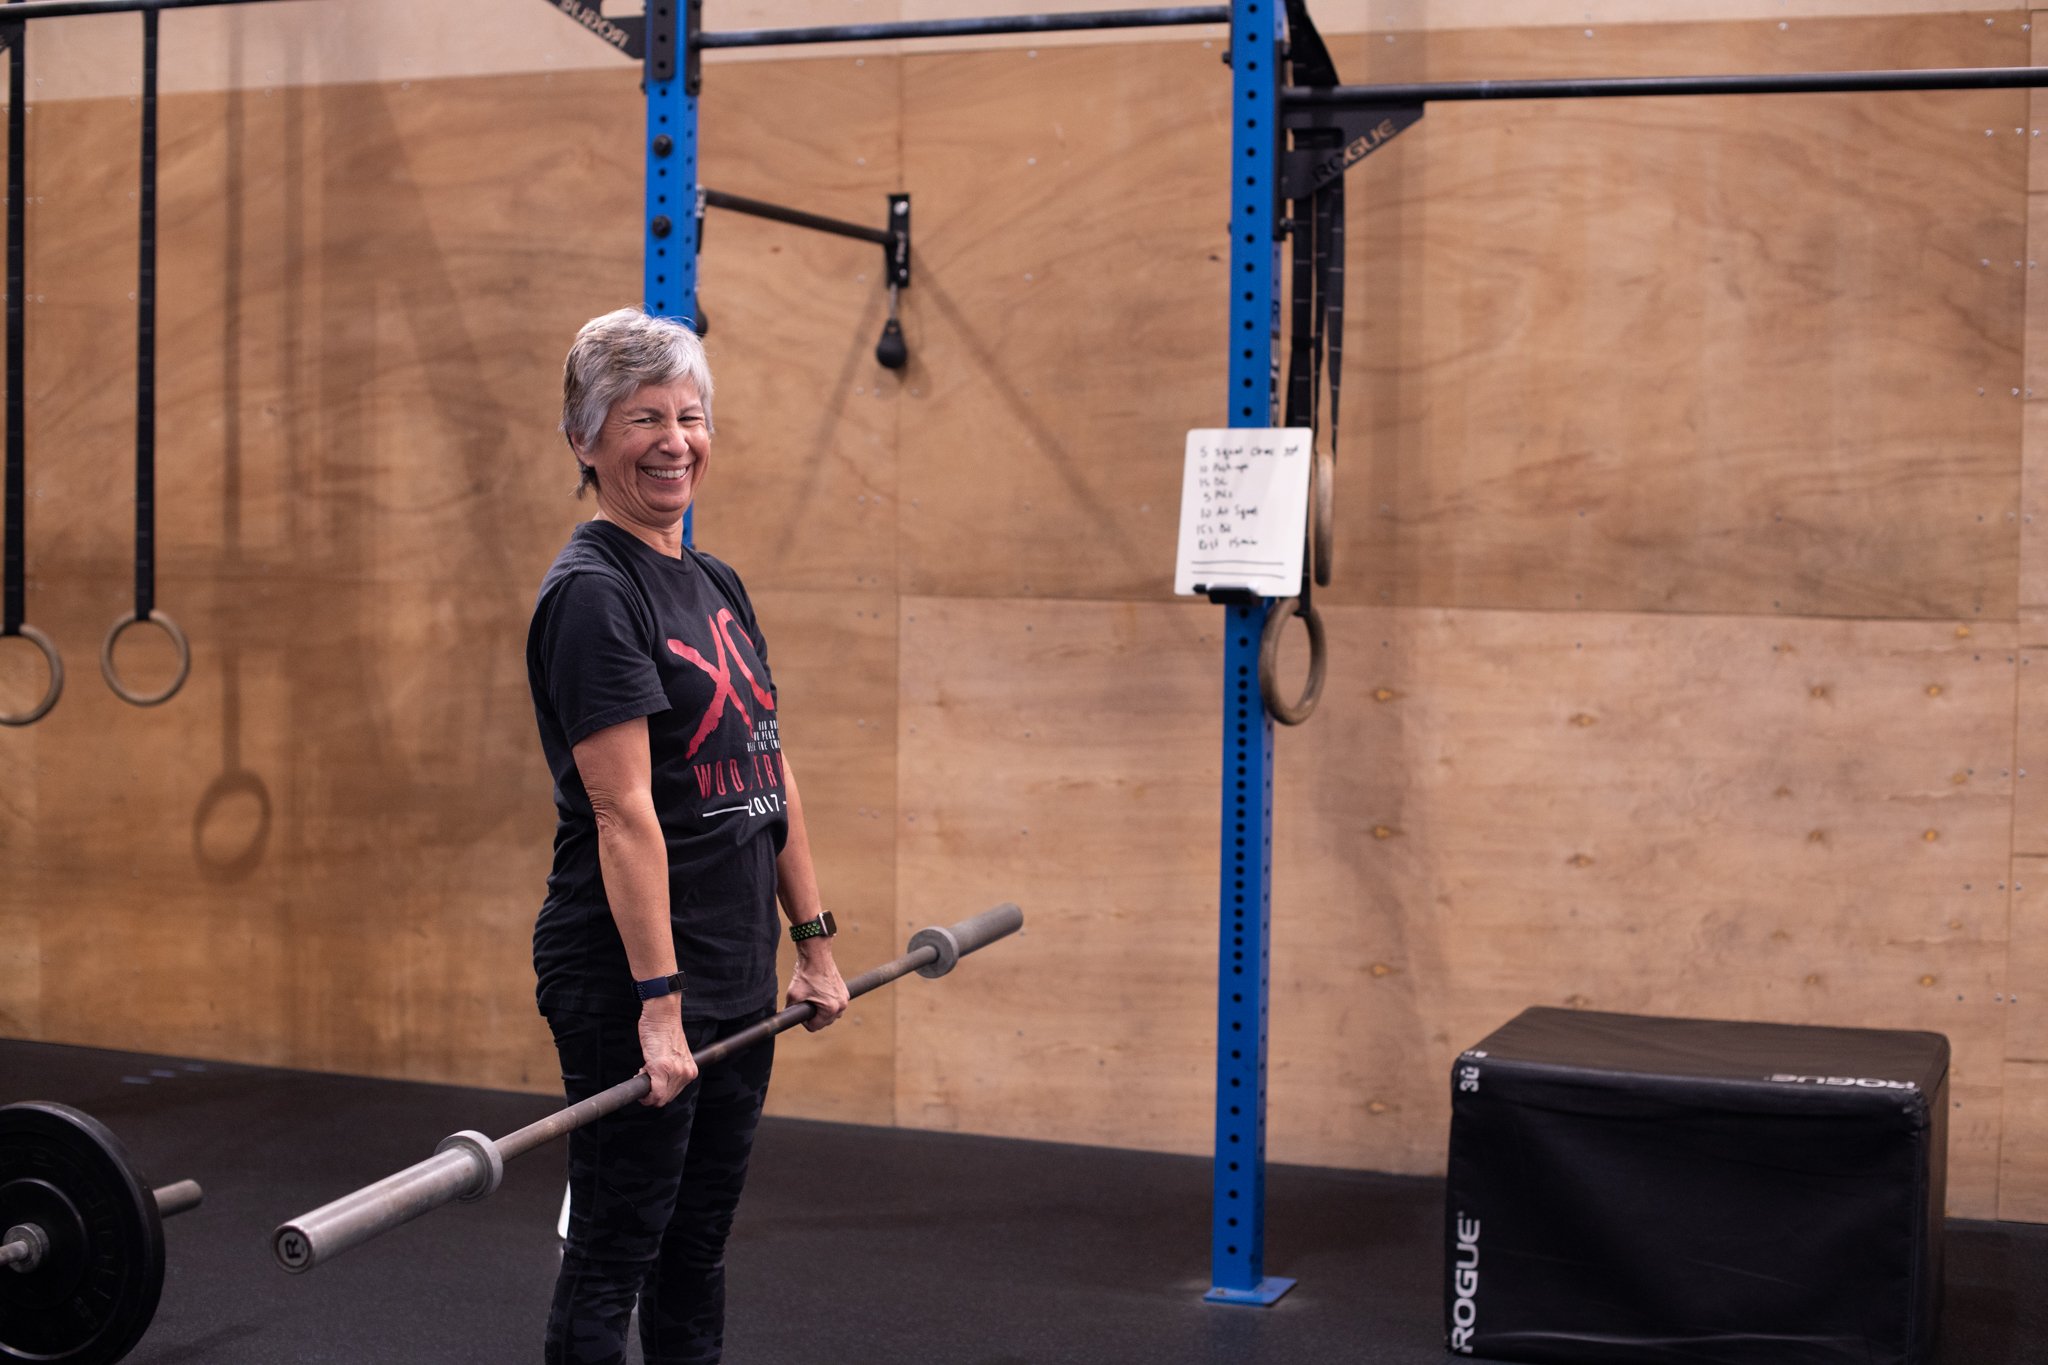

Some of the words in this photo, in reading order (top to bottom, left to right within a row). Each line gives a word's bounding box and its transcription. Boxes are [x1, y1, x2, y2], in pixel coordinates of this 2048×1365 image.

[1313, 118, 1396, 182] ROGUE
[748, 793, 780, 817] 2017
[1771, 1074, 1915, 1089] ROGUE
[1451, 1216, 1481, 1354] ROGUE
